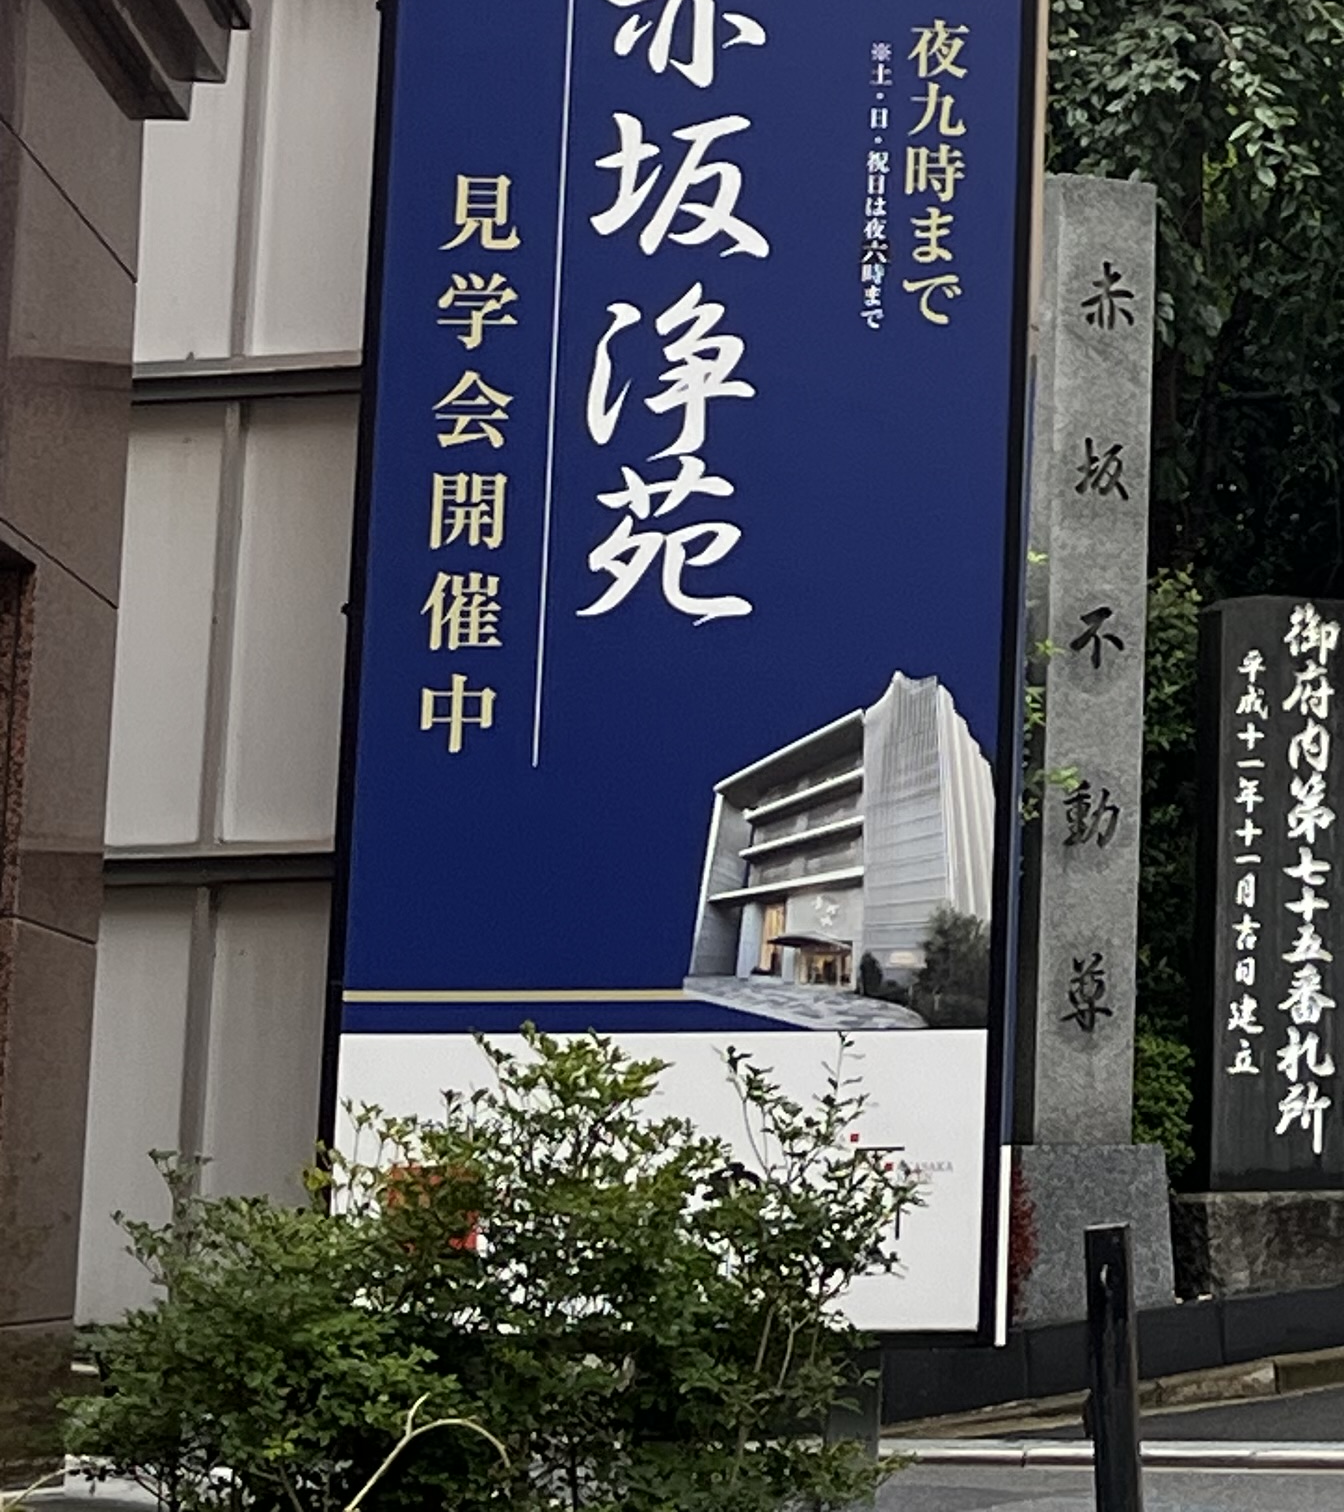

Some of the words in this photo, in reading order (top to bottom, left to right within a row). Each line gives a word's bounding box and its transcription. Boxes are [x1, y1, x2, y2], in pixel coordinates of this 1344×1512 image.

[420, 174, 521, 756] 見学会開催中
[1058, 259, 1136, 1033] 赤坂不動尊
[1226, 649, 1269, 1075] 平成十一年十一月吉日建立
